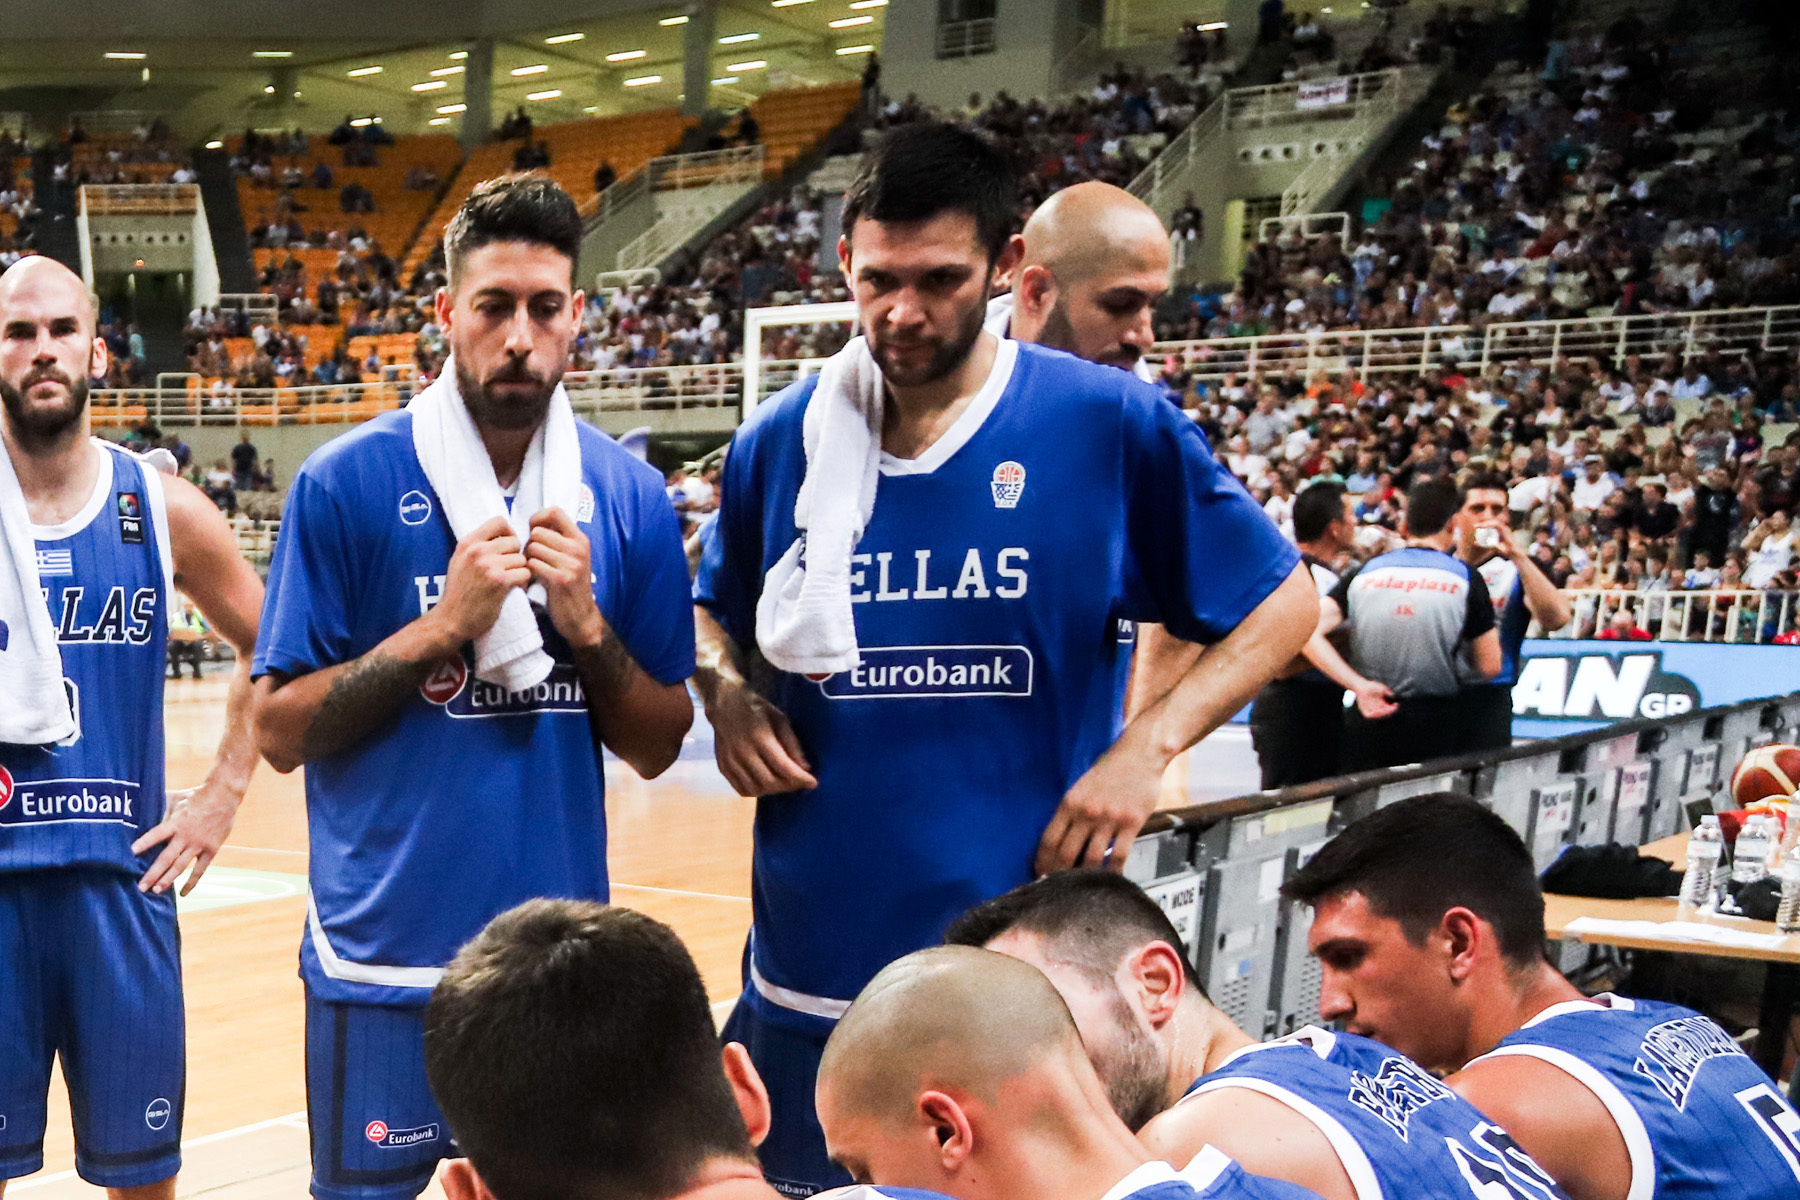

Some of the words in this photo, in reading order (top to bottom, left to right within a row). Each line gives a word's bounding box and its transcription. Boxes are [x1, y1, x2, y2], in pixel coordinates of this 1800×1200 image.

[850, 547, 1030, 604] ELLAS
[40, 586, 157, 645] LAS
[850, 656, 1012, 687] Eurobank
[1639, 693, 1693, 719] GP
[388, 1128, 434, 1144] Eurobank
[774, 1182, 814, 1196] robank
